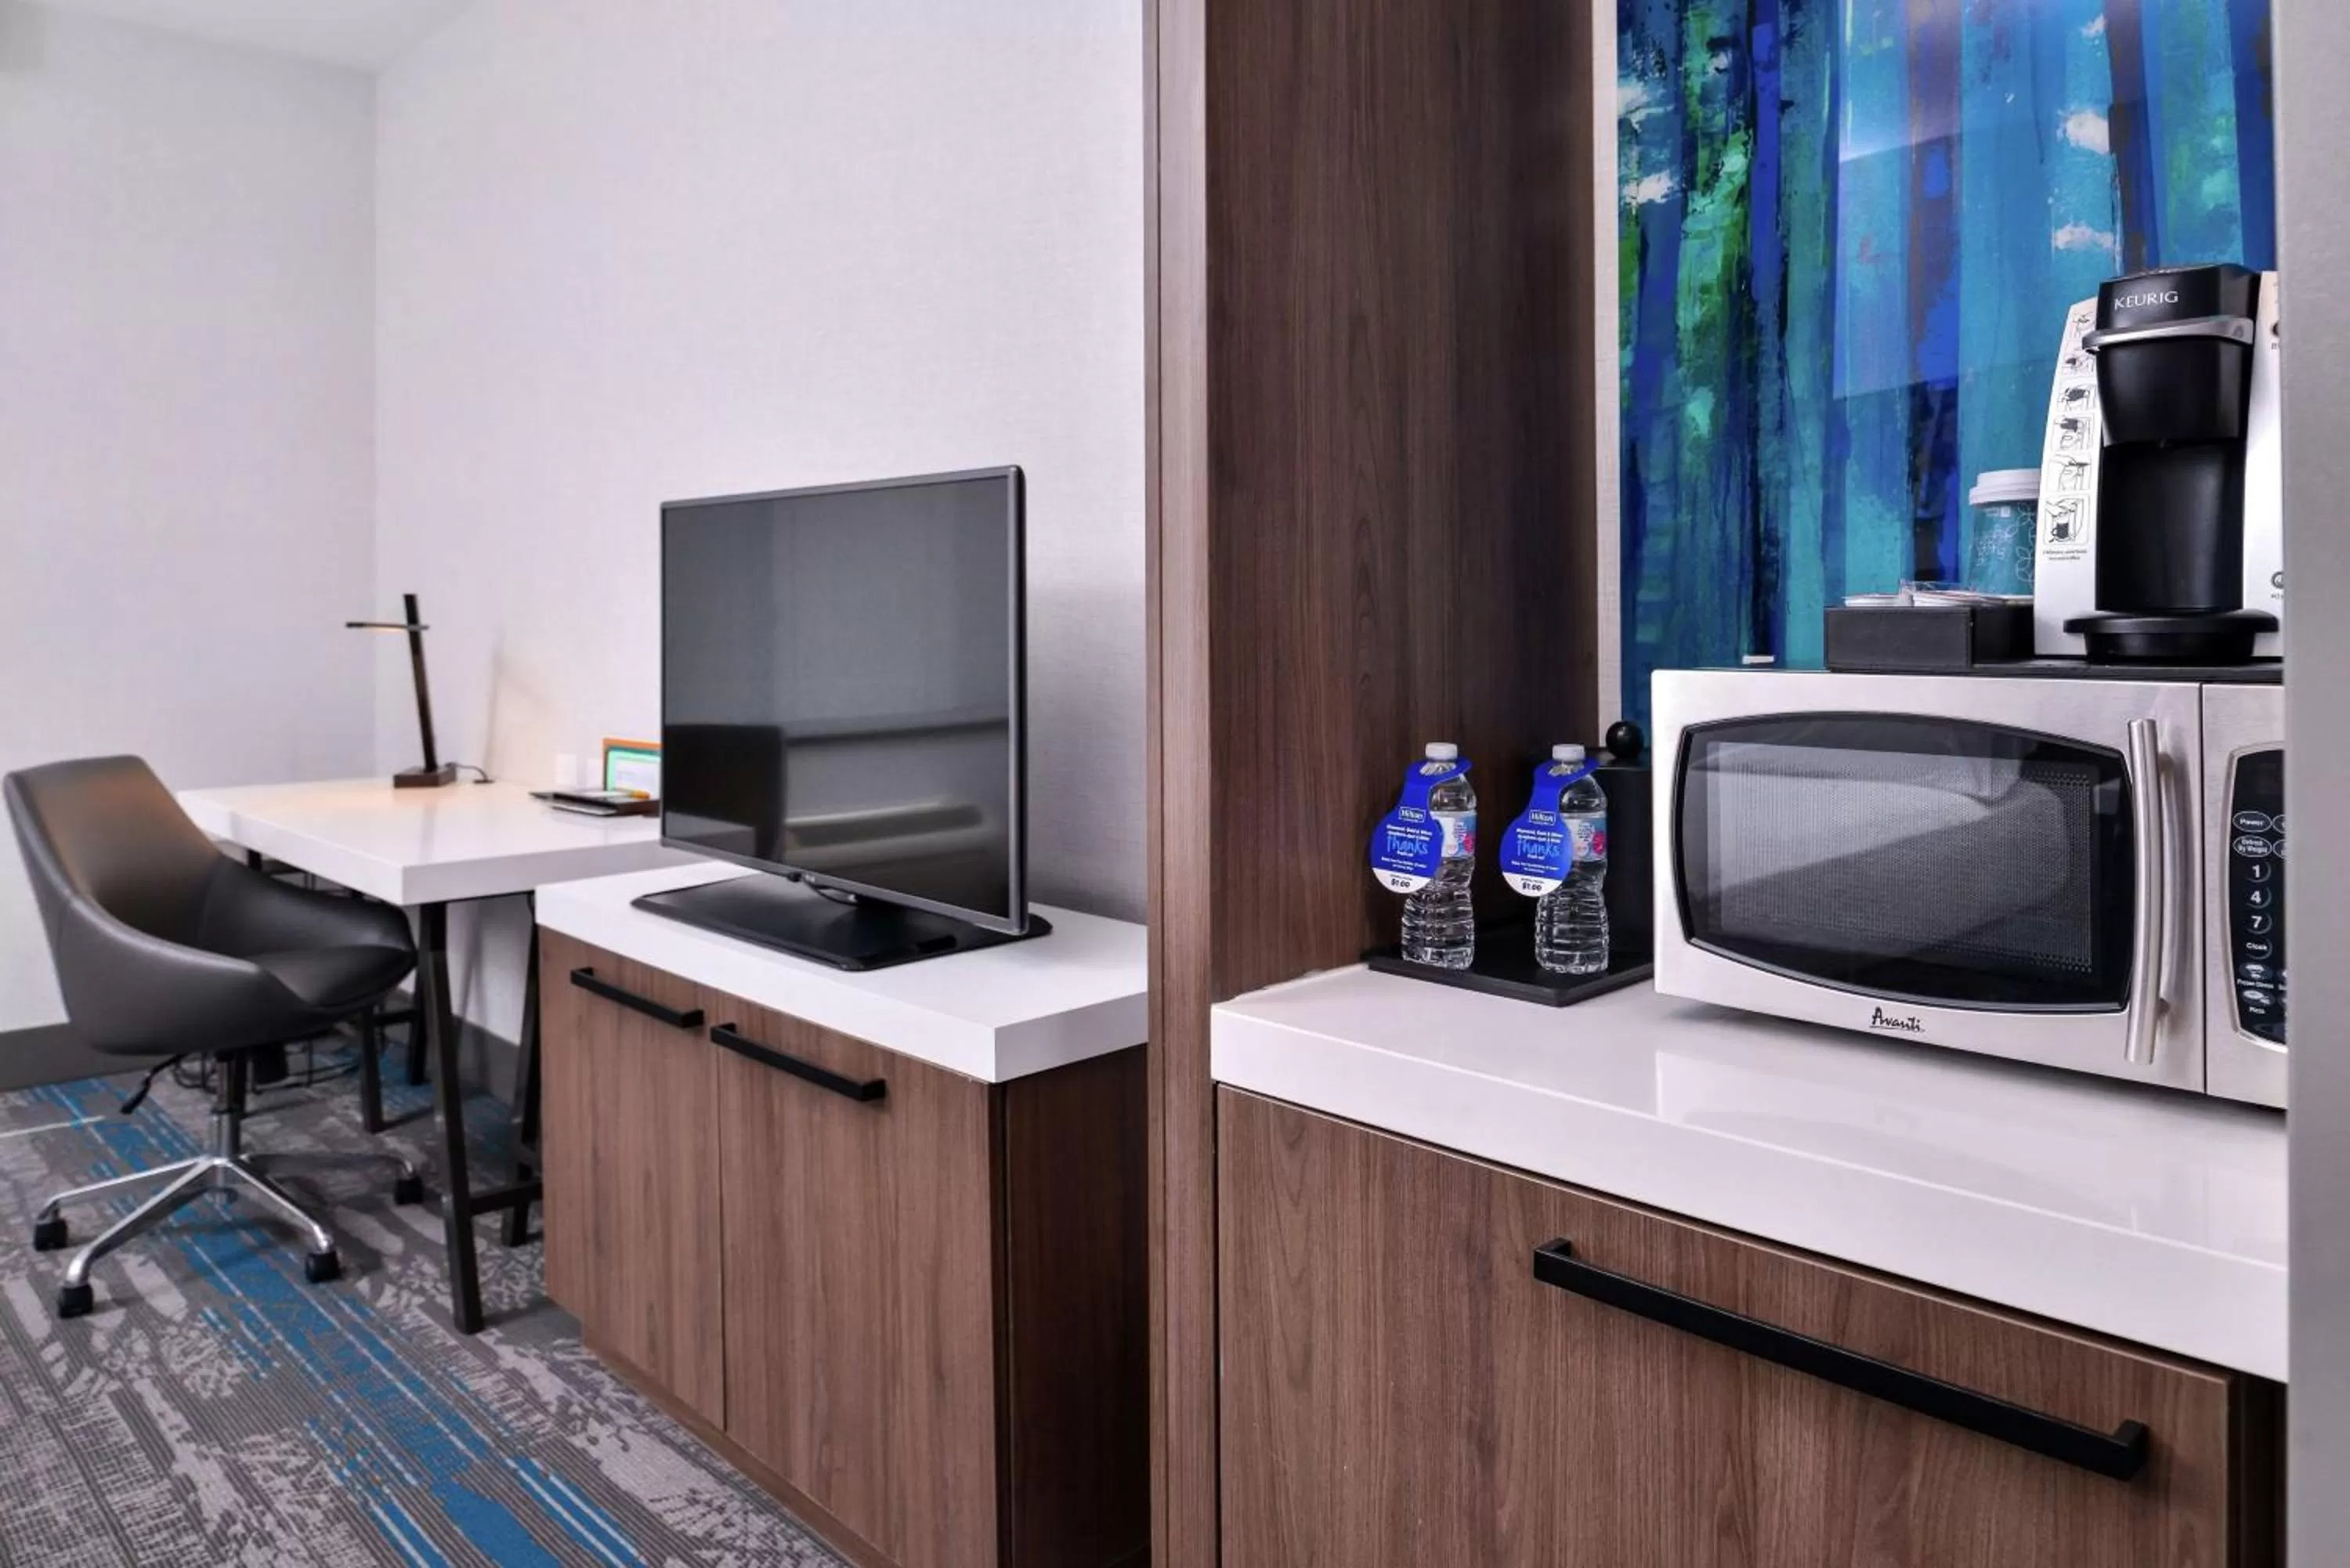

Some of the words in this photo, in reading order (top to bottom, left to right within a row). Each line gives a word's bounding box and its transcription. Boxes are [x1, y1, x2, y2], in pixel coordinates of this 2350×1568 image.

[2114, 291, 2178, 310] KEURIG
[1386, 835, 1429, 854] Thanks
[1517, 839, 1562, 858] Thanks
[2251, 865, 2260, 878] 1
[2251, 891, 2261, 903] 4
[2251, 916, 2262, 928] 7
[1871, 1006, 1922, 1033] Avanti
